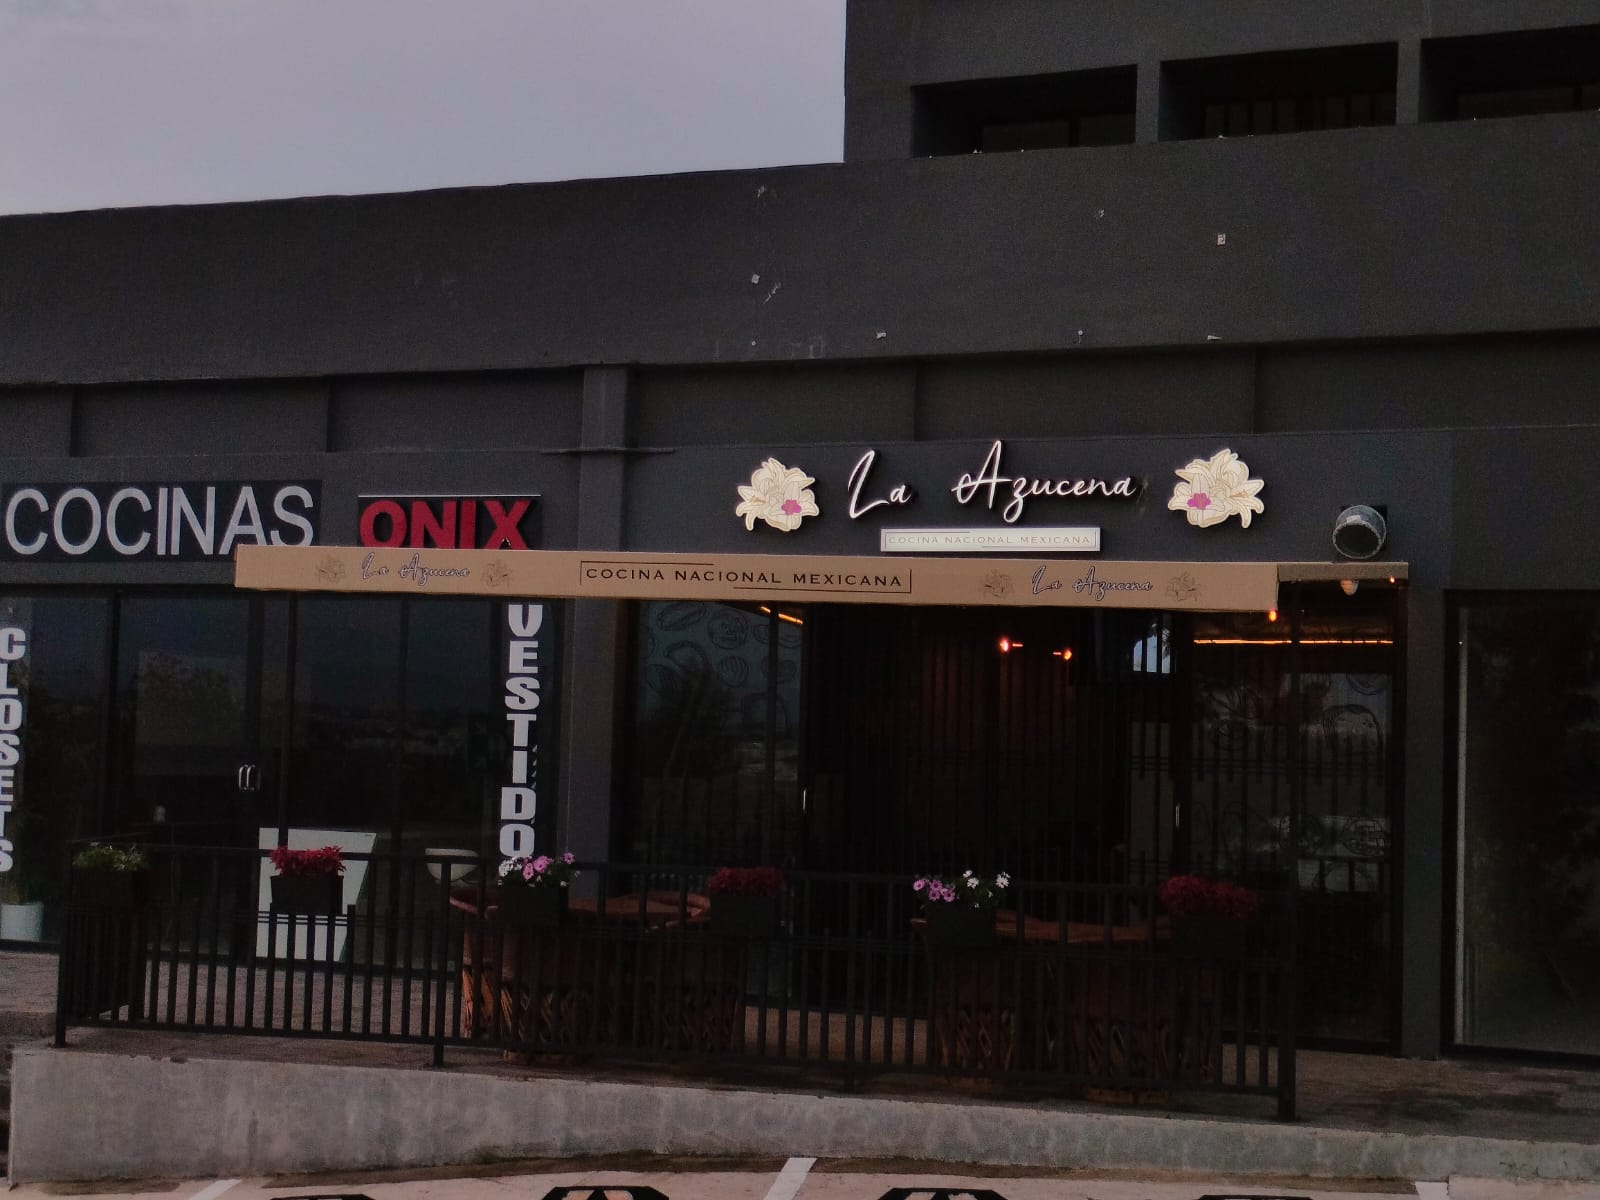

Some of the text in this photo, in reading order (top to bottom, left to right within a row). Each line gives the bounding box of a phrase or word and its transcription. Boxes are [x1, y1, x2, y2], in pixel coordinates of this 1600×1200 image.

[848, 439, 1137, 523] La Azucena
[5, 485, 313, 555] COCINAS
[359, 499, 532, 550] ONIX
[888, 535, 1091, 545] COCINA NACIONAL MEXICANA
[361, 552, 472, 586] La Azucena
[586, 568, 901, 587] COCINA NACIONAL MEXICANA
[1031, 565, 1154, 601] La Azucena
